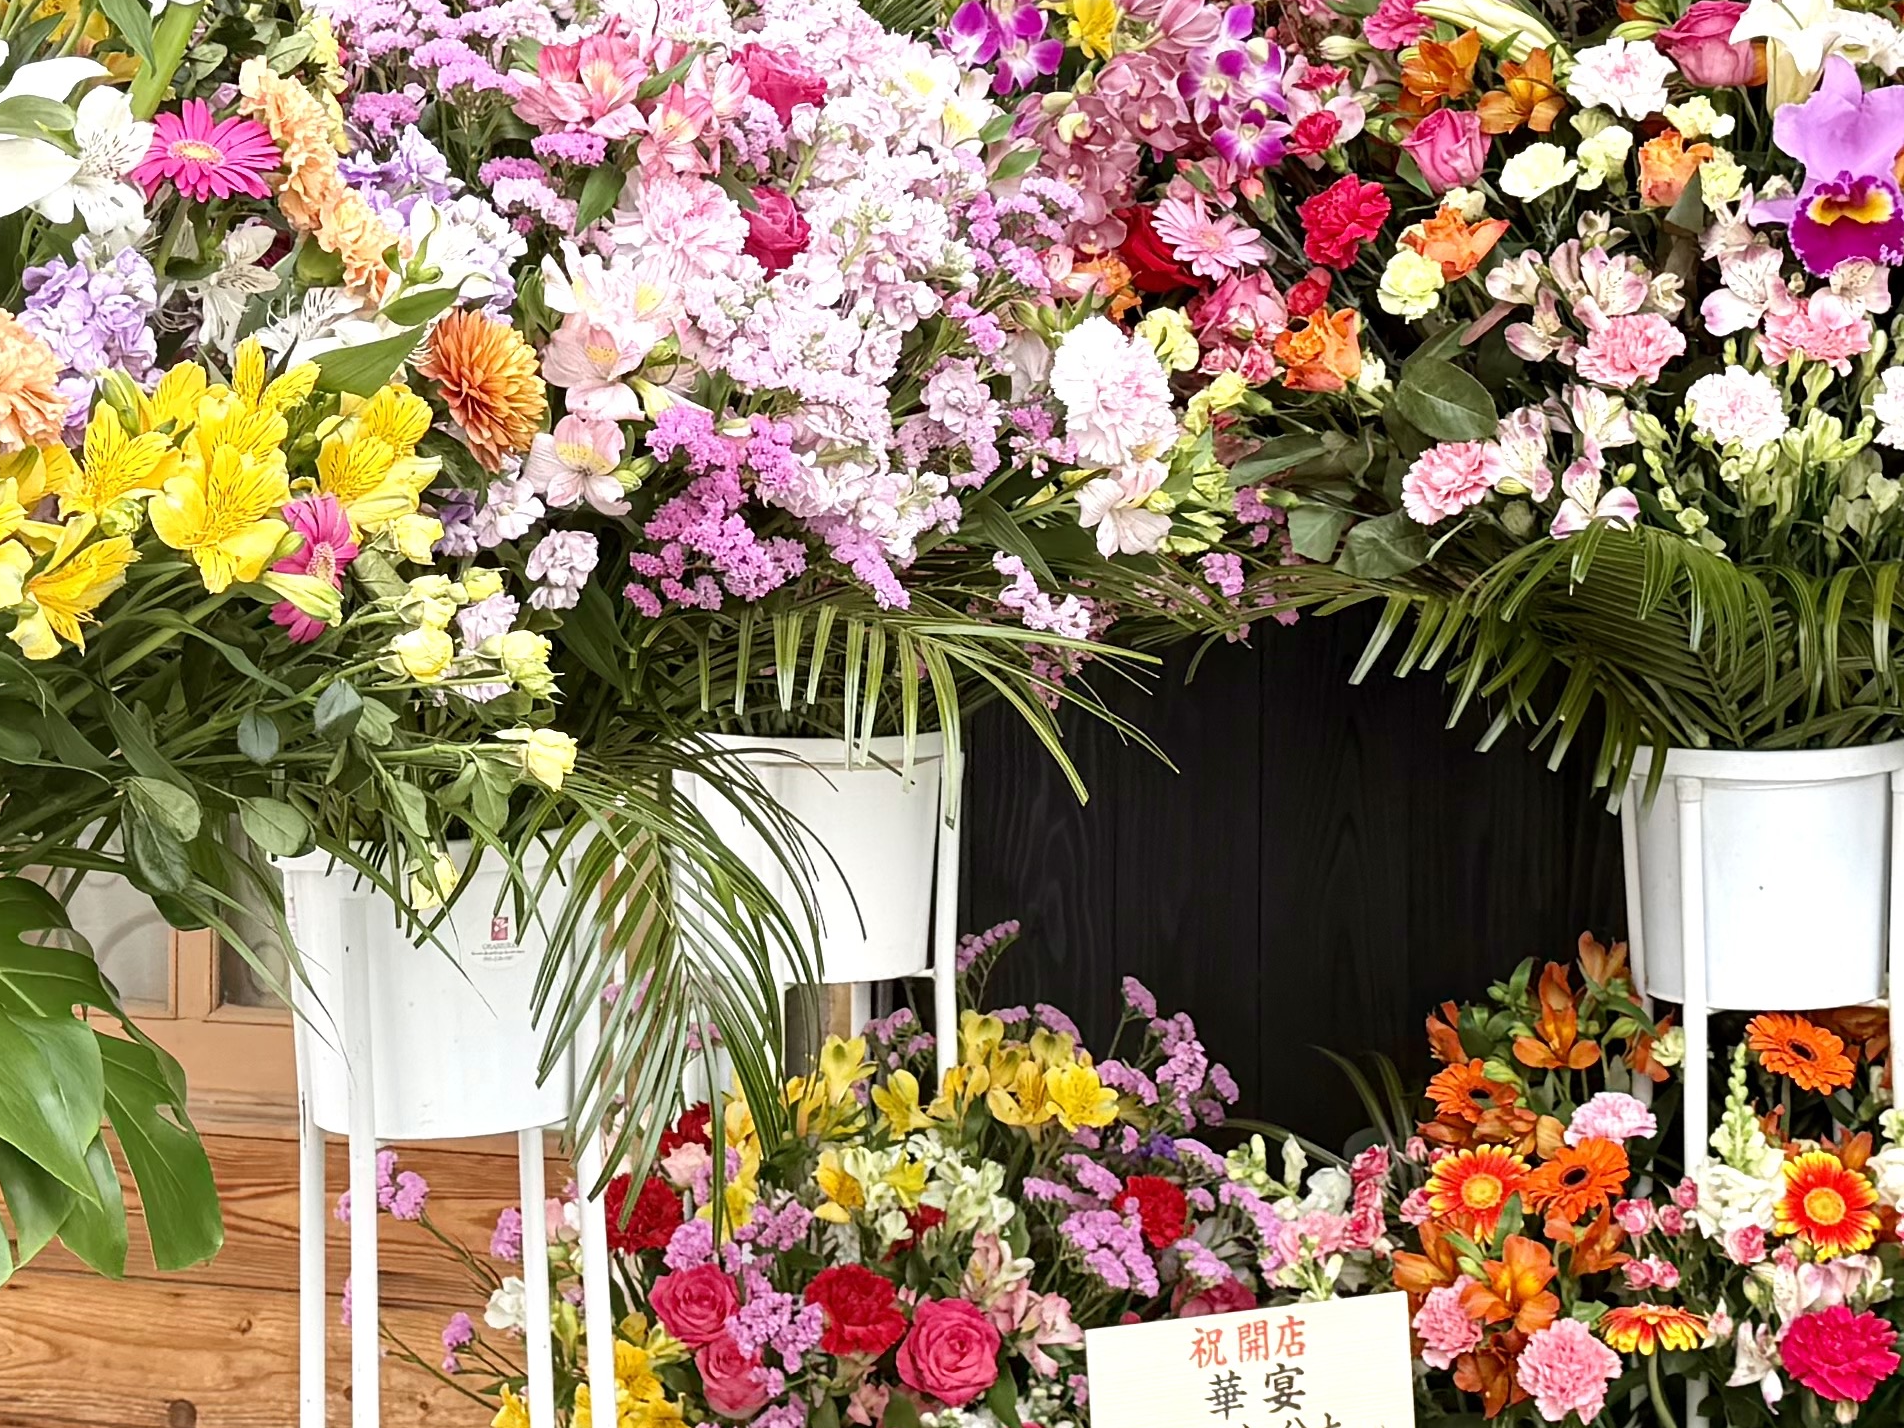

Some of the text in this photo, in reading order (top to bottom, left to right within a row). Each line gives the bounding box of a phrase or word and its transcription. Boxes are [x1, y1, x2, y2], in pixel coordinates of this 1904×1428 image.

[1188, 1314, 1307, 1370] 祝開店
[1204, 1362, 1307, 1421] 華宴
